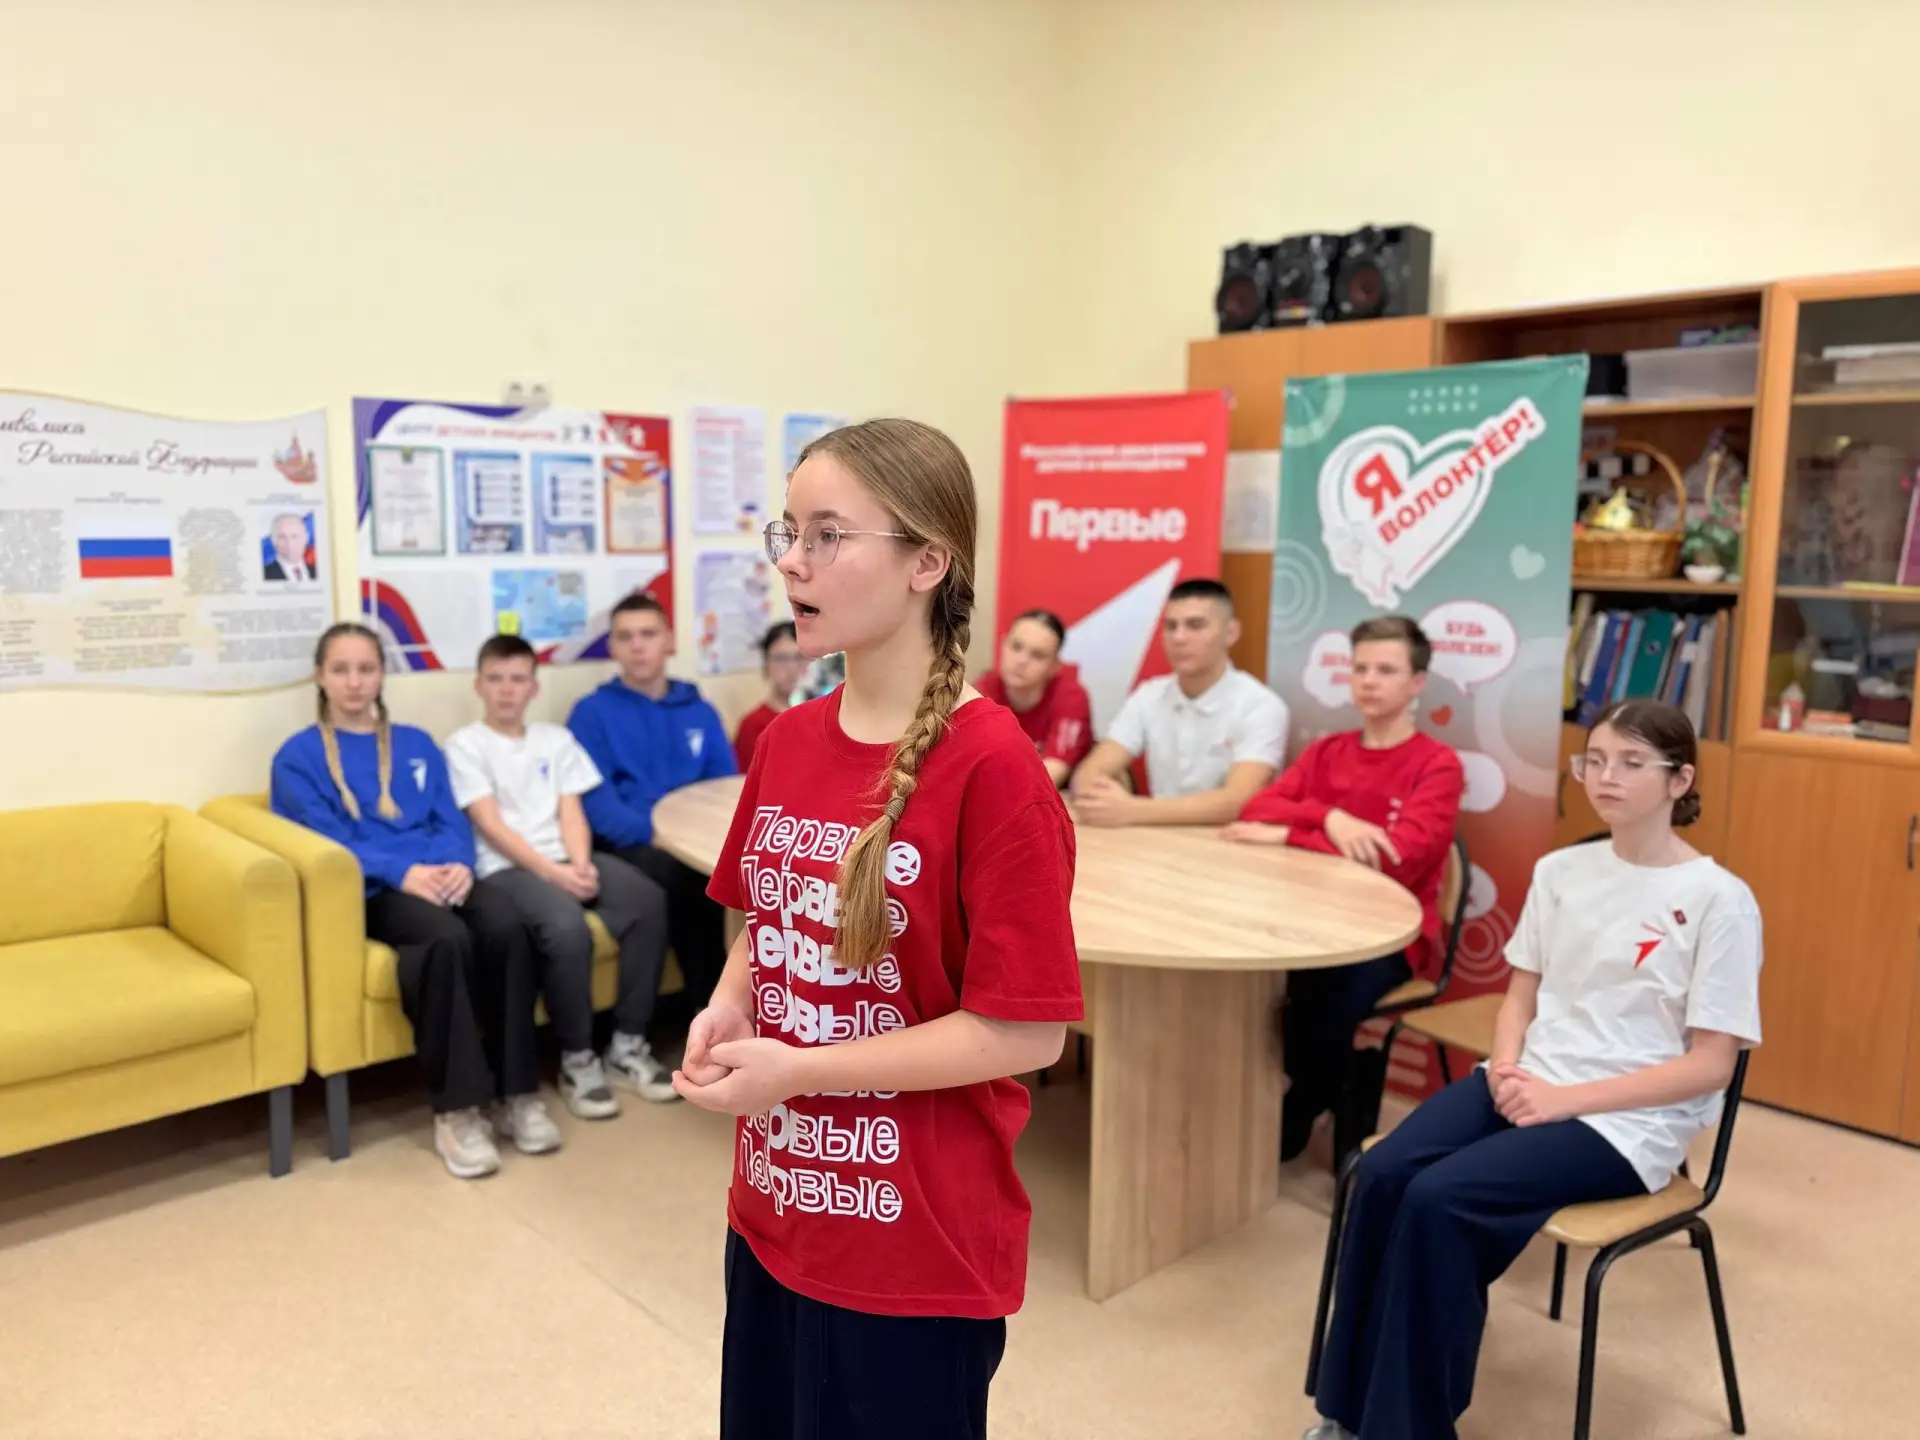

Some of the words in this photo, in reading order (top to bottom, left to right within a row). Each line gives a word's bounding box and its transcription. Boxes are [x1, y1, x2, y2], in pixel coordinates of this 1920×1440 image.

[1353, 453, 1403, 518] Я
[1378, 407, 1535, 543] ВОЛОНТЁР!
[1030, 500, 1186, 551] Первые
[744, 805, 921, 886] Перве
